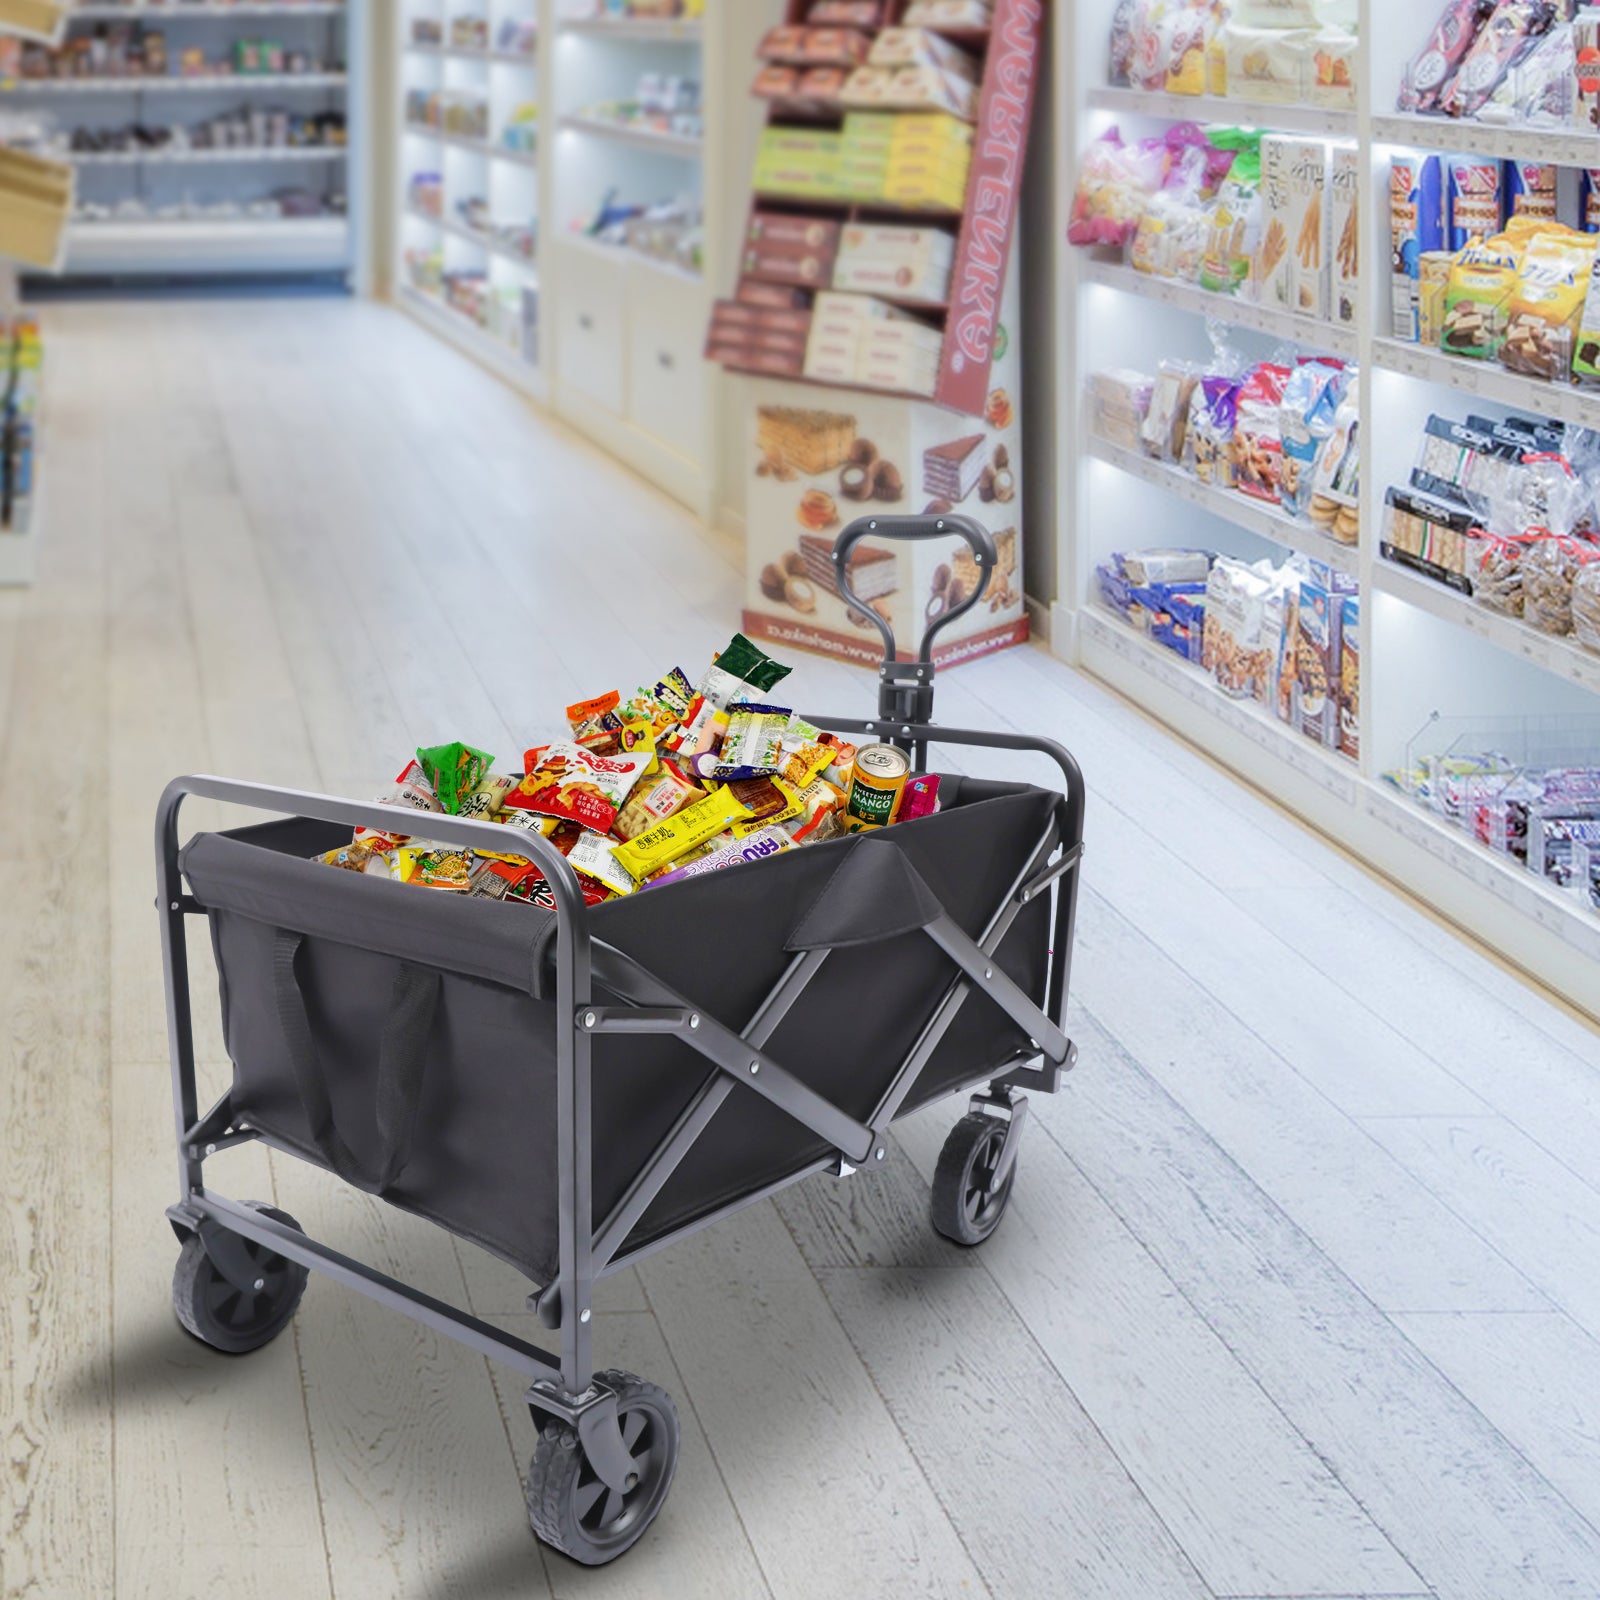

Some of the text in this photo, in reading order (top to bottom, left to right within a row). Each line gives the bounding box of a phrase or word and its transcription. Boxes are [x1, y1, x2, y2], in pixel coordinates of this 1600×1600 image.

[799, 784, 819, 802] OTATO
[853, 791, 891, 809] MANGO
[855, 785, 892, 801] SWEETENED
[635, 826, 669, 849] 香蕉牛奶
[721, 831, 769, 859] YOGURT
